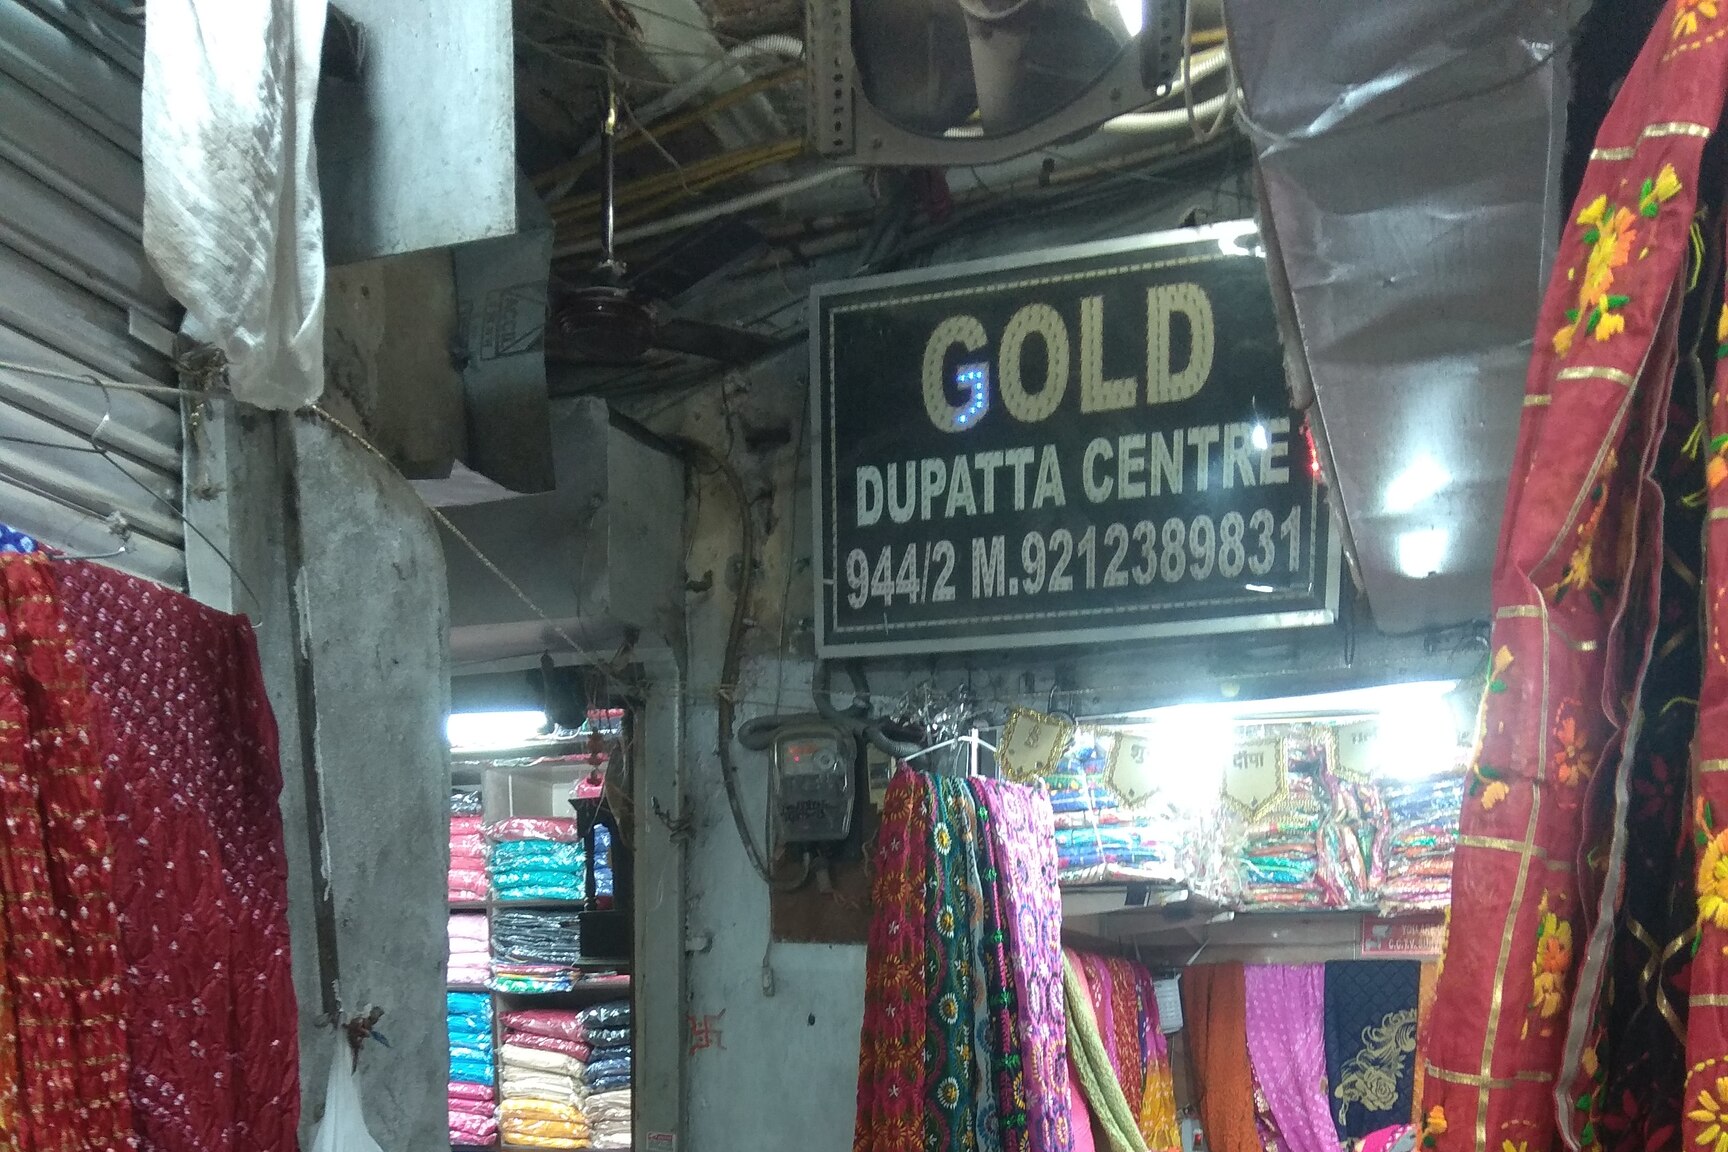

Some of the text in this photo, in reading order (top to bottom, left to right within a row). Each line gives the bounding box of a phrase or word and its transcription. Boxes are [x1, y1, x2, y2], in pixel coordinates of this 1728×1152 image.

[921, 281, 1216, 433] GOLD
[855, 418, 1291, 528] DUPATTA CENTRE
[847, 505, 1303, 610] 944/2 M.9212389831
